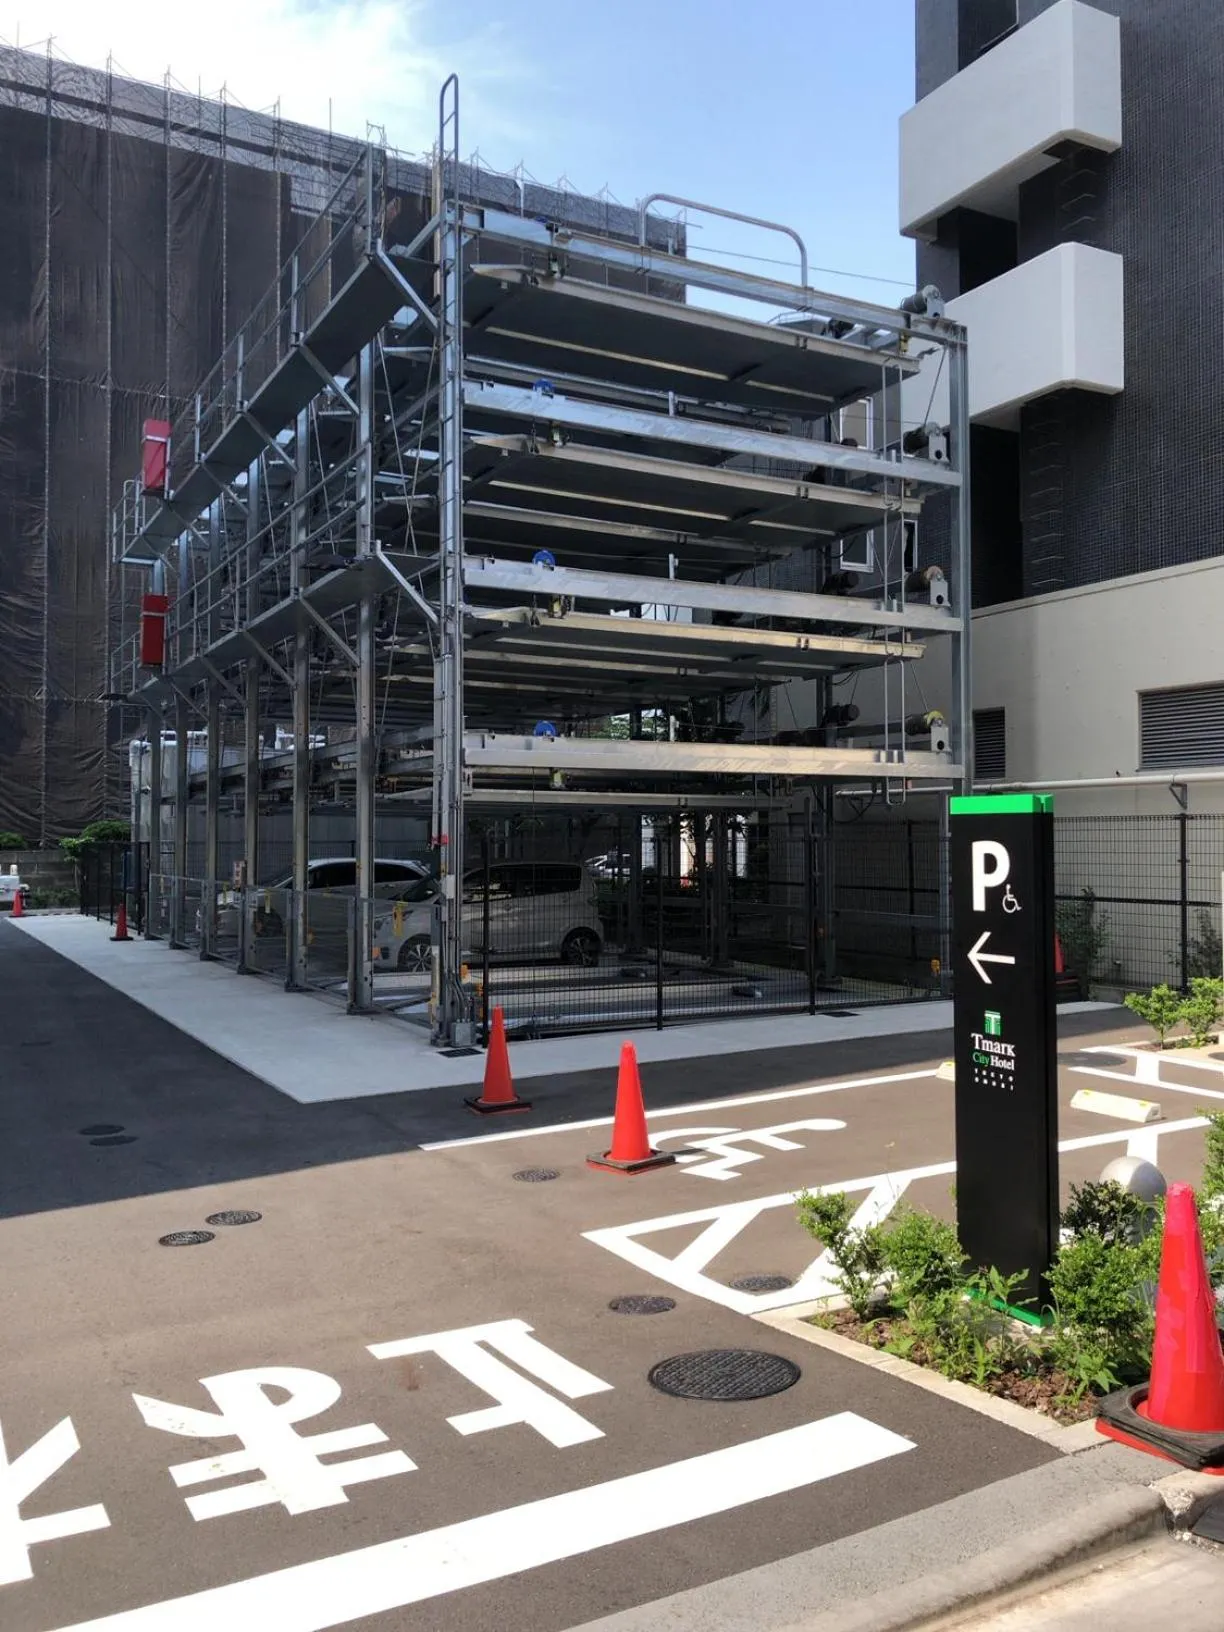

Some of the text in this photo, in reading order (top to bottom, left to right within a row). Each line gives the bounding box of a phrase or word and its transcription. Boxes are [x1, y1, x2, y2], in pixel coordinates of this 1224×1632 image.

[972, 840, 1010, 912] P
[970, 1032, 1016, 1057] Tmark
[972, 1051, 1015, 1071] City Hotel
